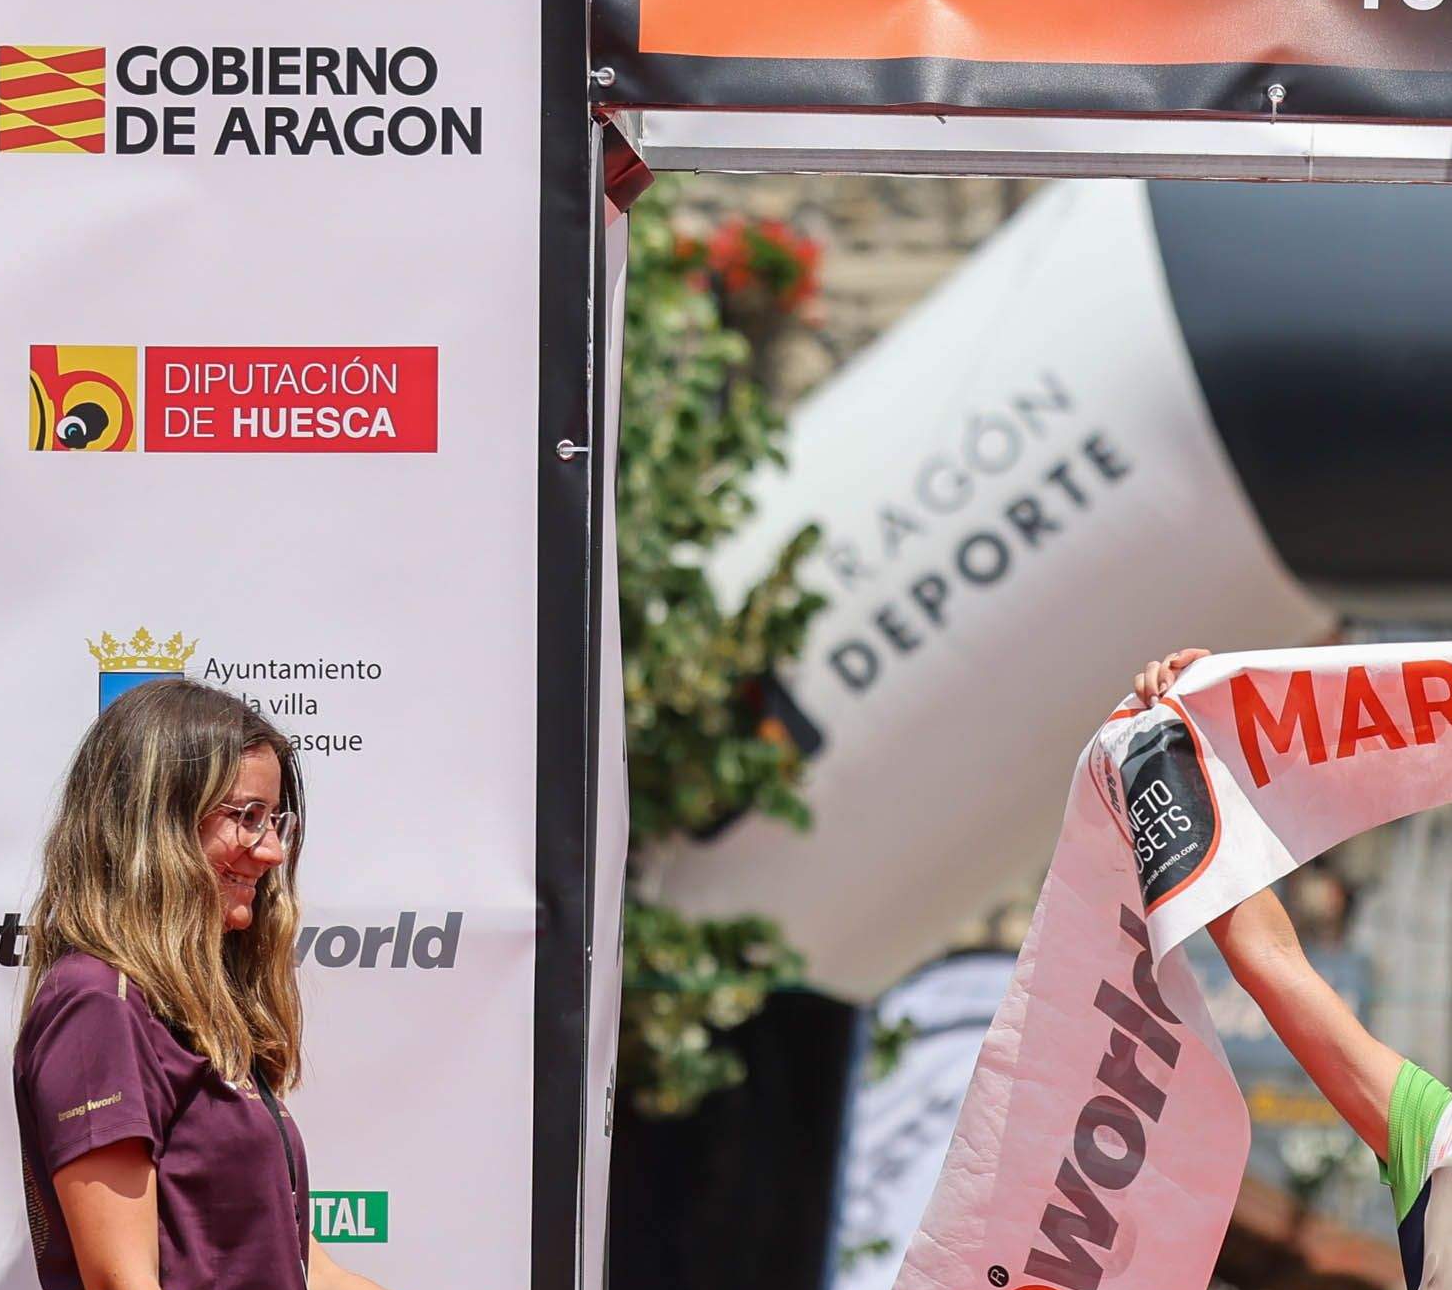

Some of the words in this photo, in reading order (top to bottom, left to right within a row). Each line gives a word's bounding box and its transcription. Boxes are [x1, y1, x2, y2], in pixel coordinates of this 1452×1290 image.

[115, 45, 438, 98] GOBIERNO
[115, 107, 197, 156] DE
[213, 106, 484, 156] ARAGON
[162, 355, 398, 396] DIPUTACIÓN
[162, 407, 216, 439] DE
[231, 406, 397, 439] HUESCA
[829, 369, 1078, 597] RAGÓN
[828, 431, 1136, 695] DEPORTE
[203, 655, 384, 687] Ayuntamiento
[268, 692, 320, 716] villa
[289, 730, 364, 757] asque
[1128, 778, 1174, 839] NETO
[1134, 804, 1192, 875] OSETS
